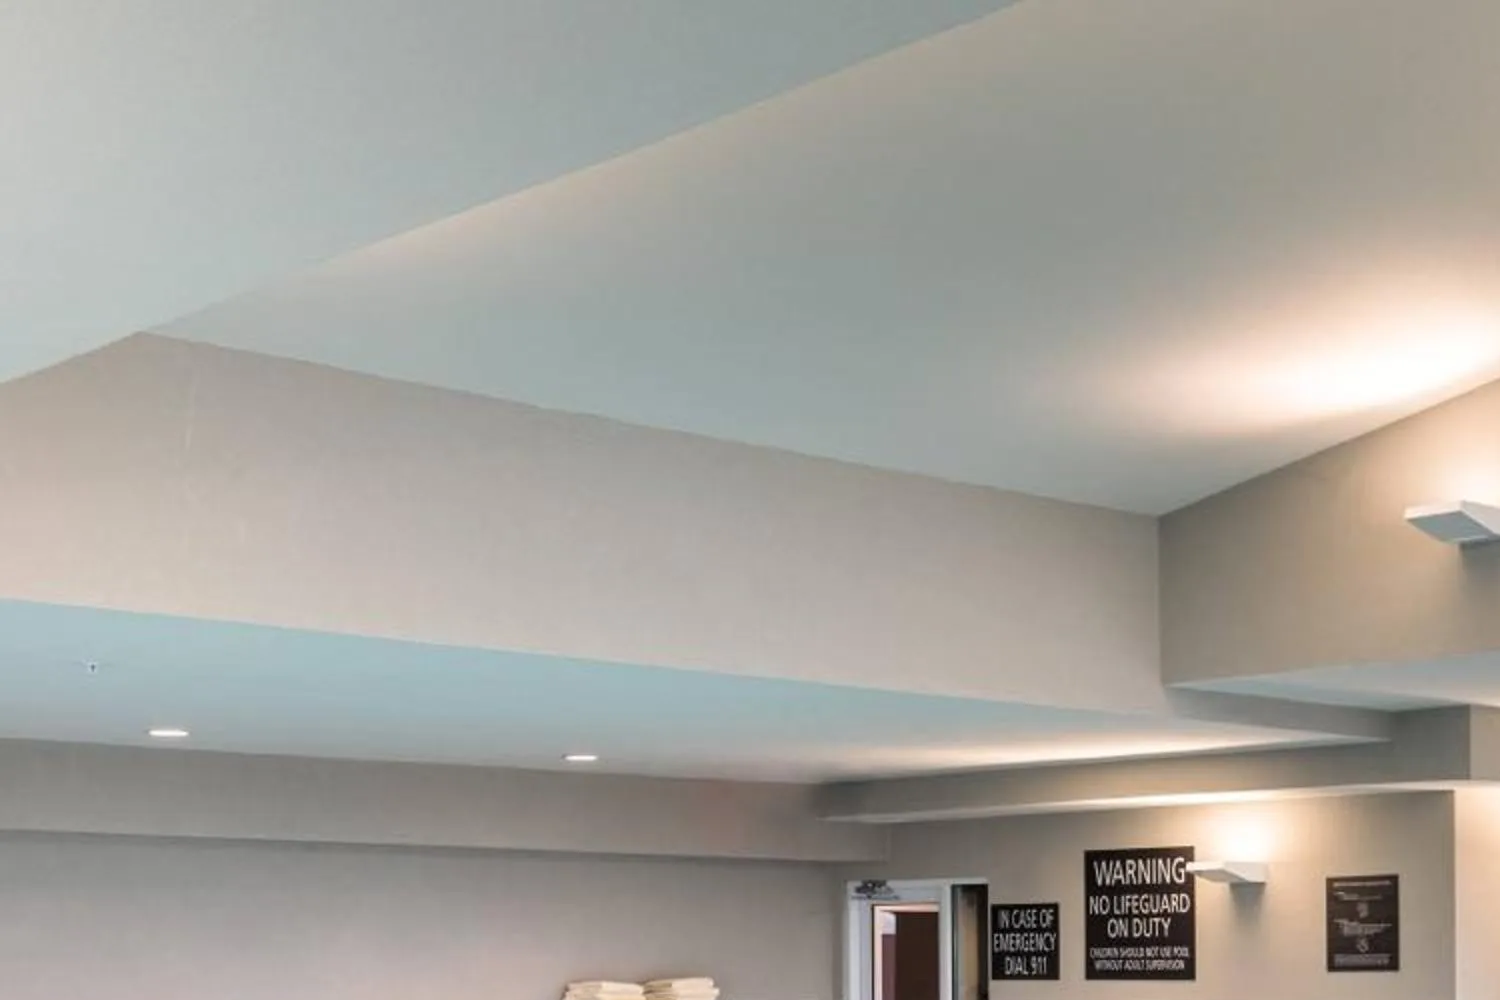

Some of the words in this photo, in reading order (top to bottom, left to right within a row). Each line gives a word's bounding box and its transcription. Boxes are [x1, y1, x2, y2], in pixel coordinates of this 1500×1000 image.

[1093, 857, 1186, 886] WARNING
[1089, 895, 1110, 915] NO
[1113, 893, 1191, 914] LIFEGUARD
[1011, 909, 1037, 929] CASE
[1040, 909, 1055, 928] OF
[1107, 918, 1129, 938] ON
[1132, 917, 1171, 938] DUTY
[993, 932, 1057, 952] EMERGENCY
[1004, 956, 1029, 976] DIAL
[1031, 956, 1048, 975] 911
